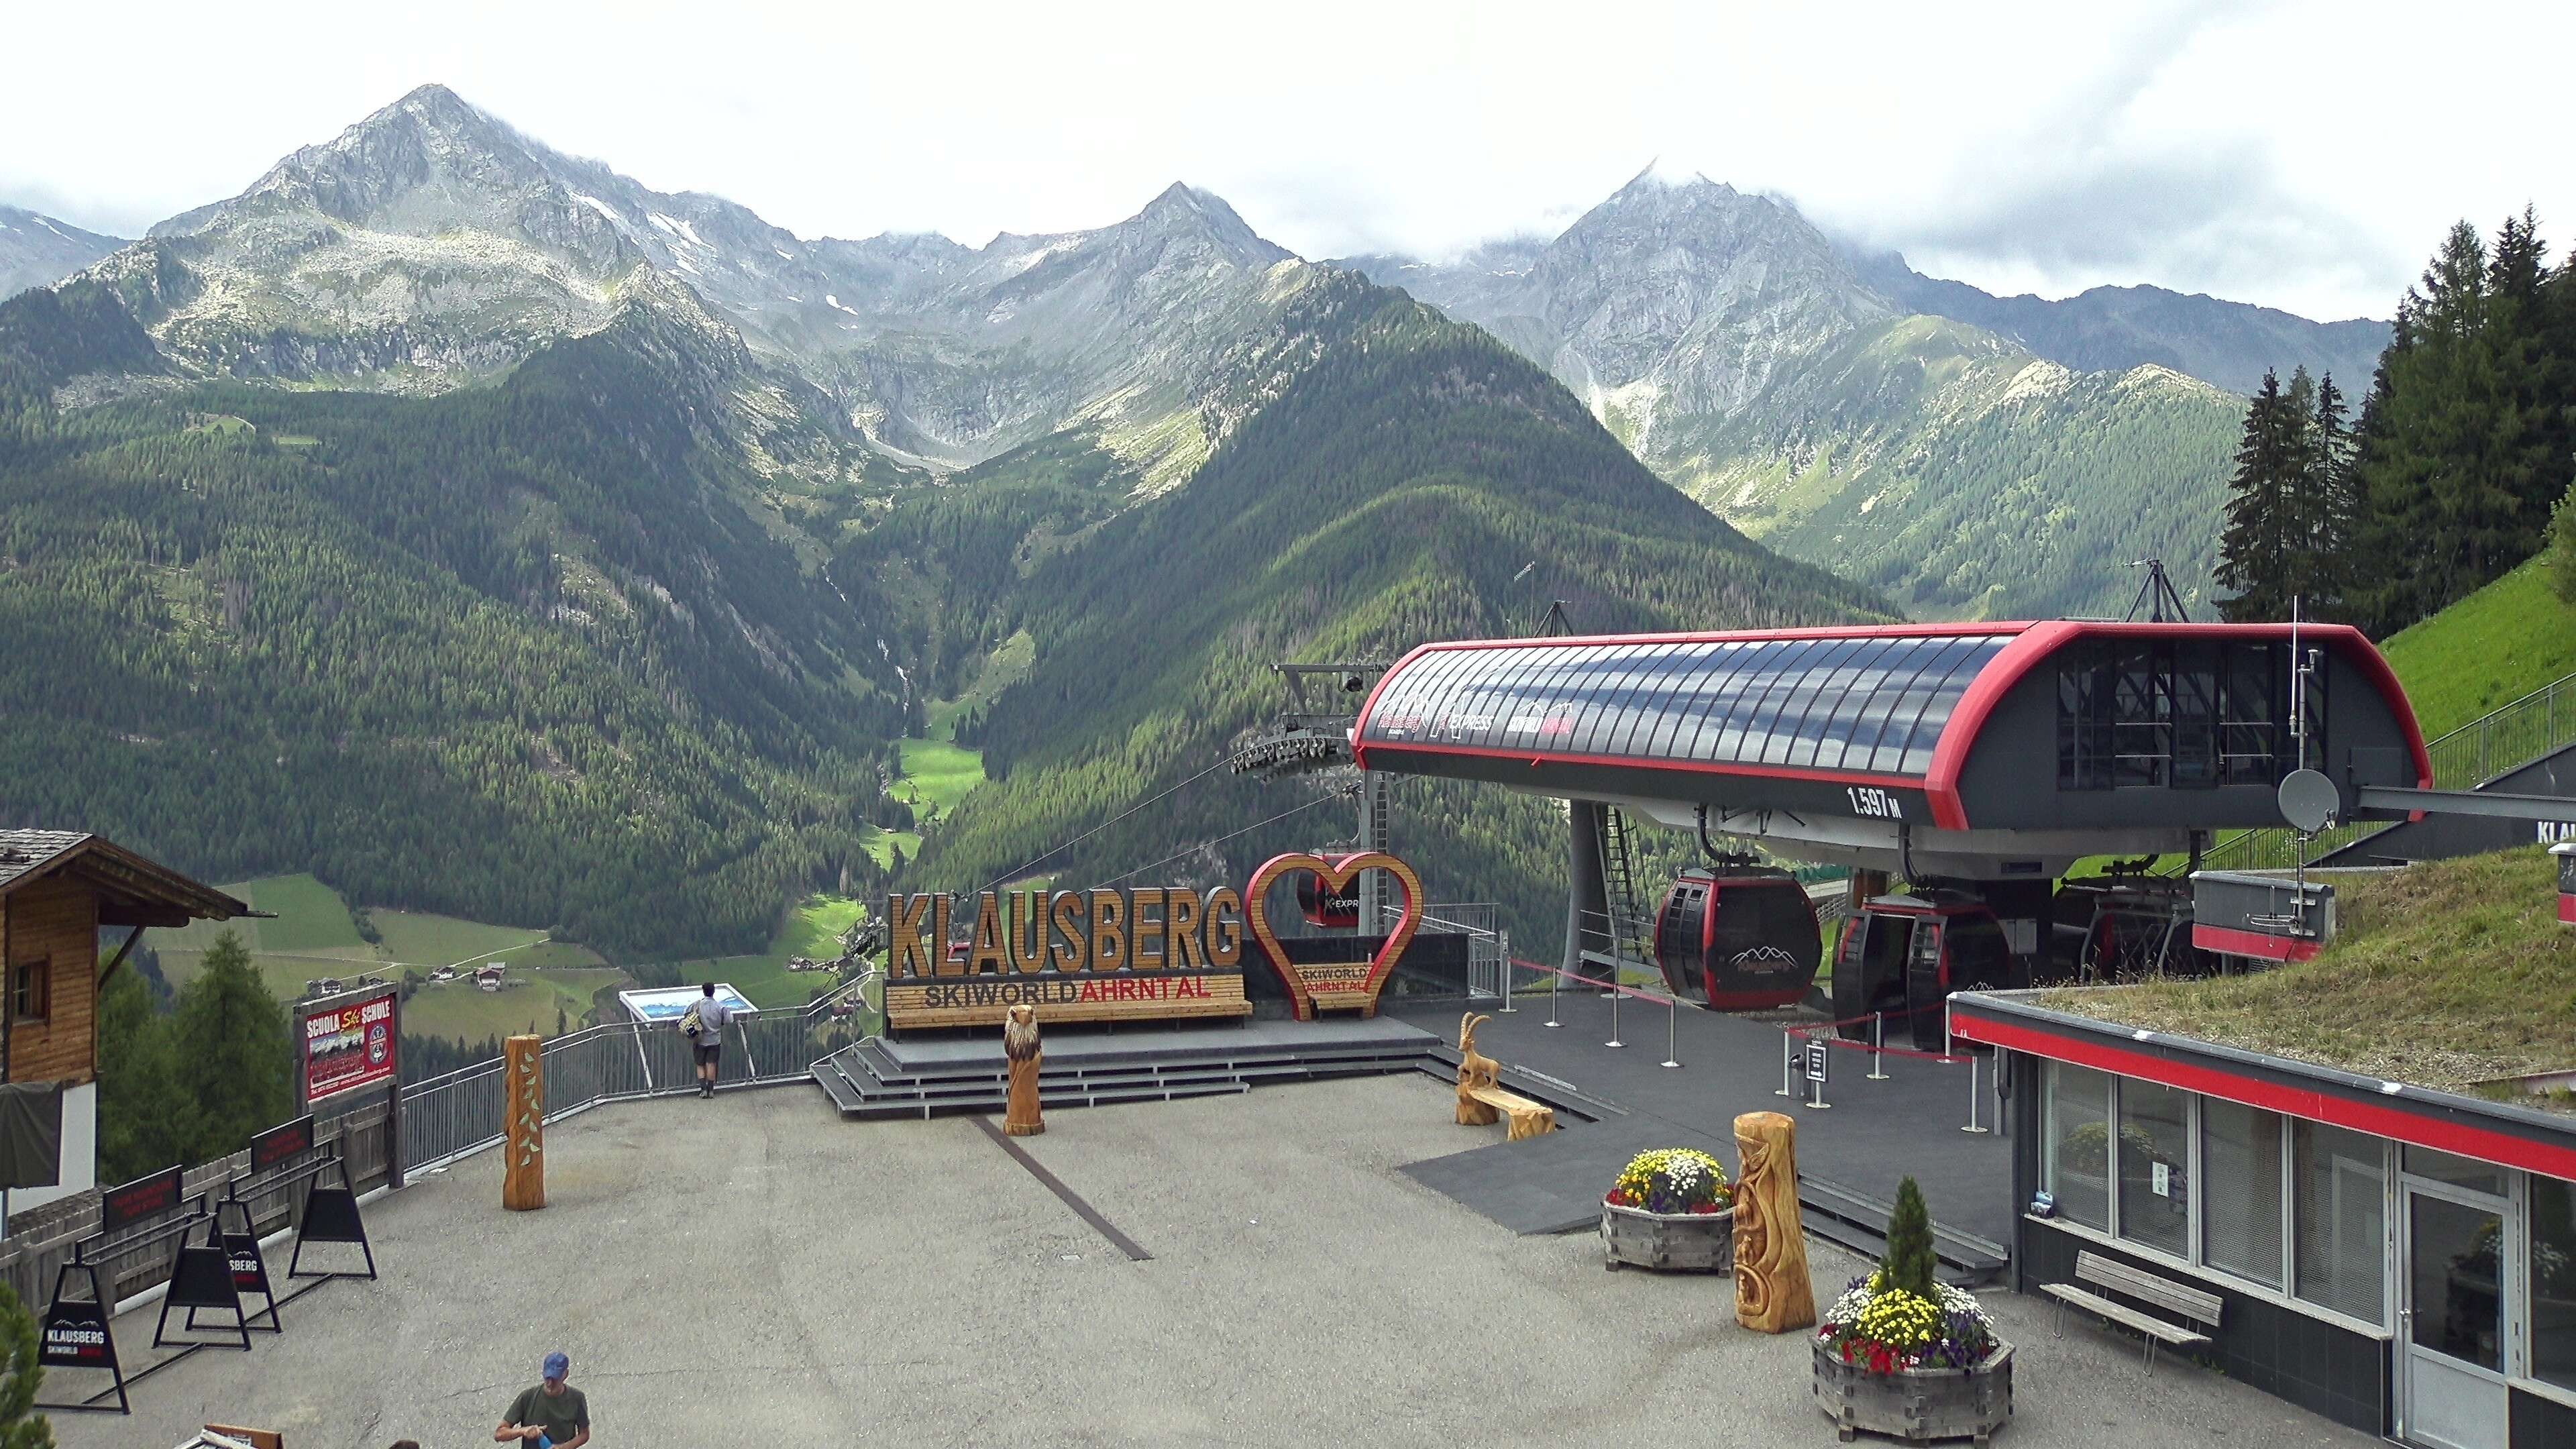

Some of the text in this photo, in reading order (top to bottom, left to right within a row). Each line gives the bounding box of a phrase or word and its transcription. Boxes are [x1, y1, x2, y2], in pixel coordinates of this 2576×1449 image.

[1847, 787, 1902, 819] 1.597 M
[889, 886, 1242, 979] KLAUSBERG
[1302, 968, 1367, 979] SKIWORLD
[1306, 981, 1364, 992] AHRNTAL
[307, 1000, 390, 1038] SCUOLA Ski SCHULE
[229, 1259, 257, 1272] SBERG
[48, 1329, 104, 1344] KLAUSBERG
